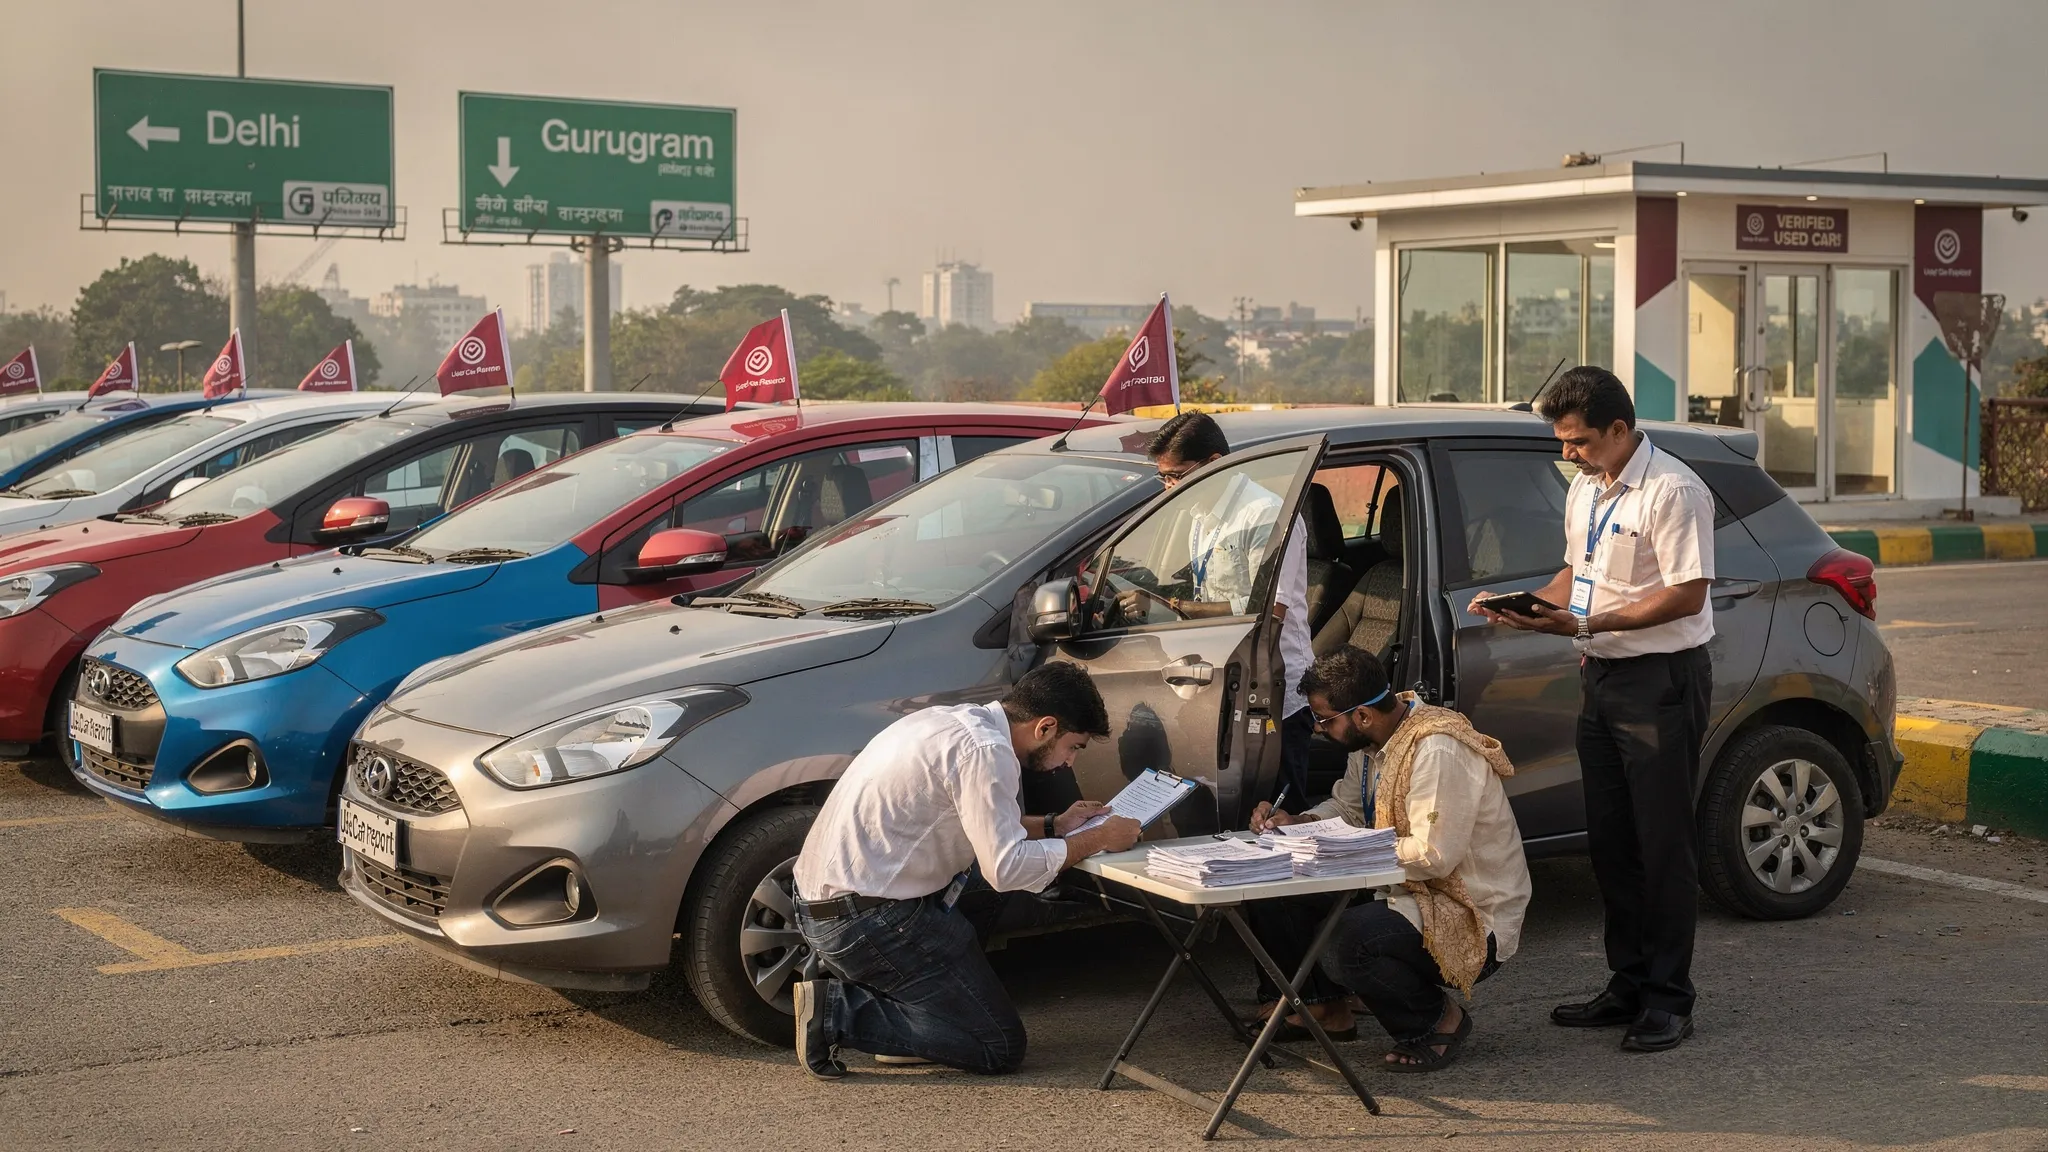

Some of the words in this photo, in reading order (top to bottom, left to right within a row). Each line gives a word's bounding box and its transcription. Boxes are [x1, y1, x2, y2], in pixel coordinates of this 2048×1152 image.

[207, 110, 300, 148] Delhi
[541, 118, 714, 164] Gurugram
[1776, 214, 1835, 230] VERIFIED
[1774, 231, 1809, 246] USED
